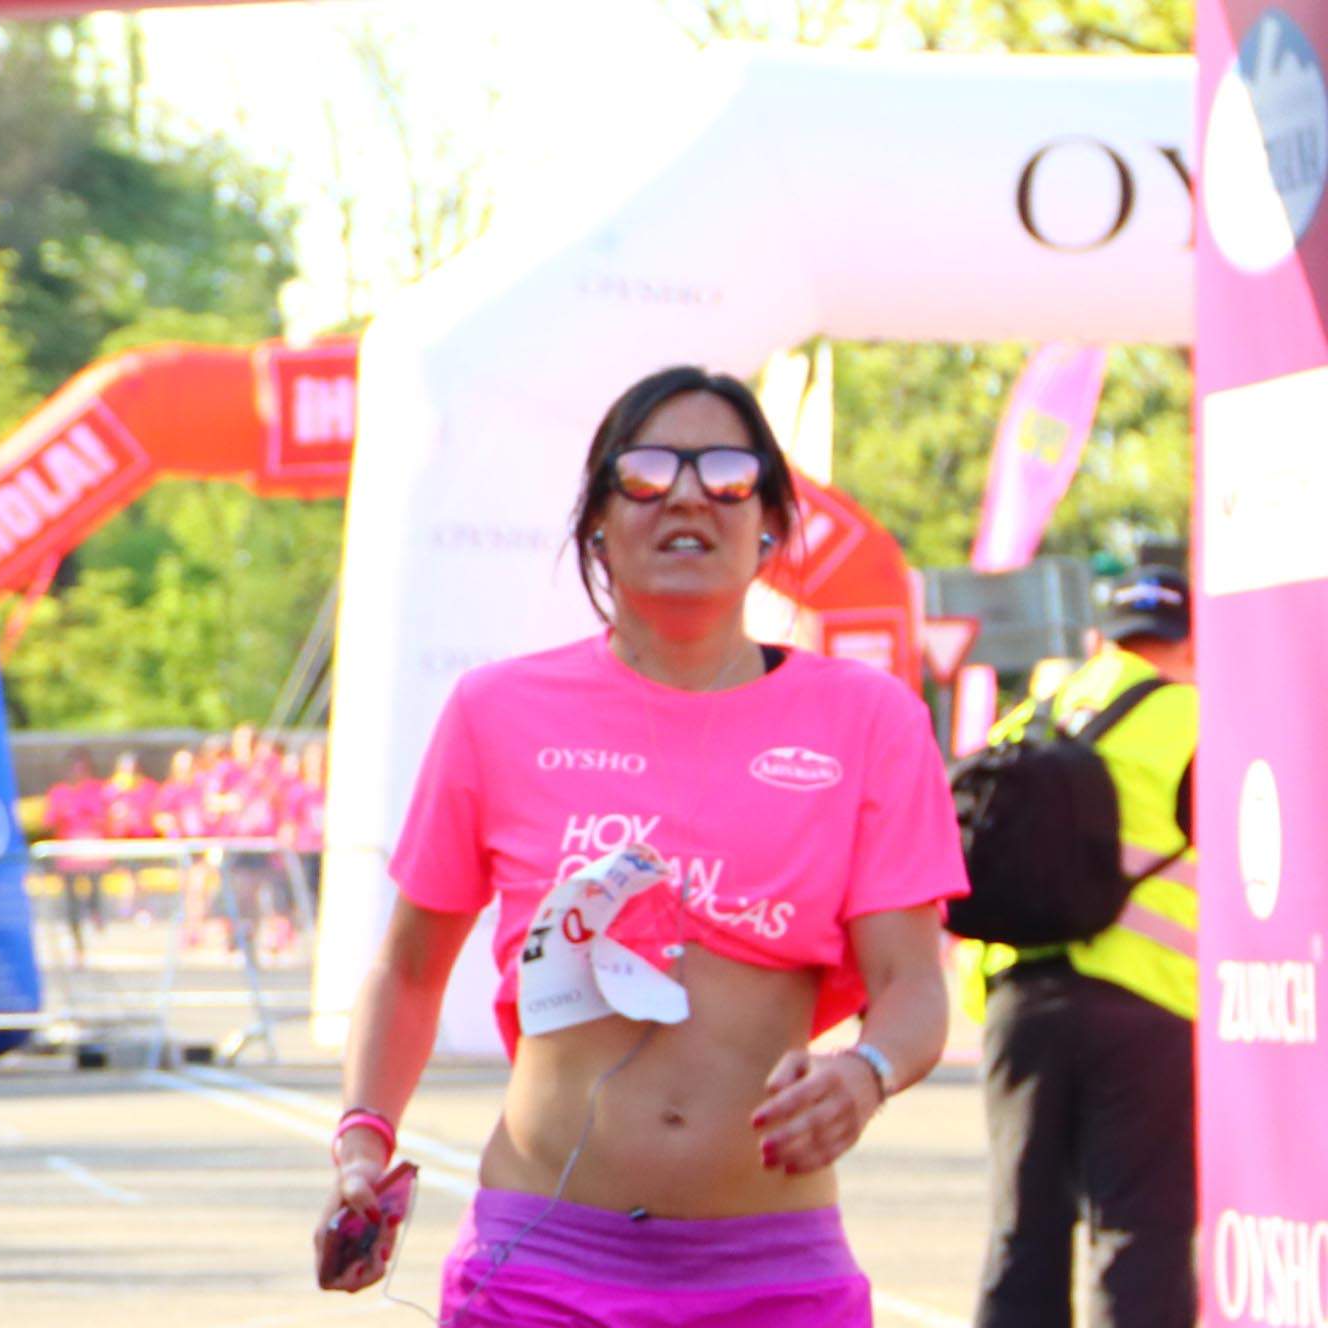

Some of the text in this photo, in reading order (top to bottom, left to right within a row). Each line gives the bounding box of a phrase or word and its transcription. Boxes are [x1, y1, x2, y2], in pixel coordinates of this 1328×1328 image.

[537, 746, 647, 775] OYSHO
[560, 813, 661, 851] HOY
[1216, 959, 1319, 1044] ZURICH
